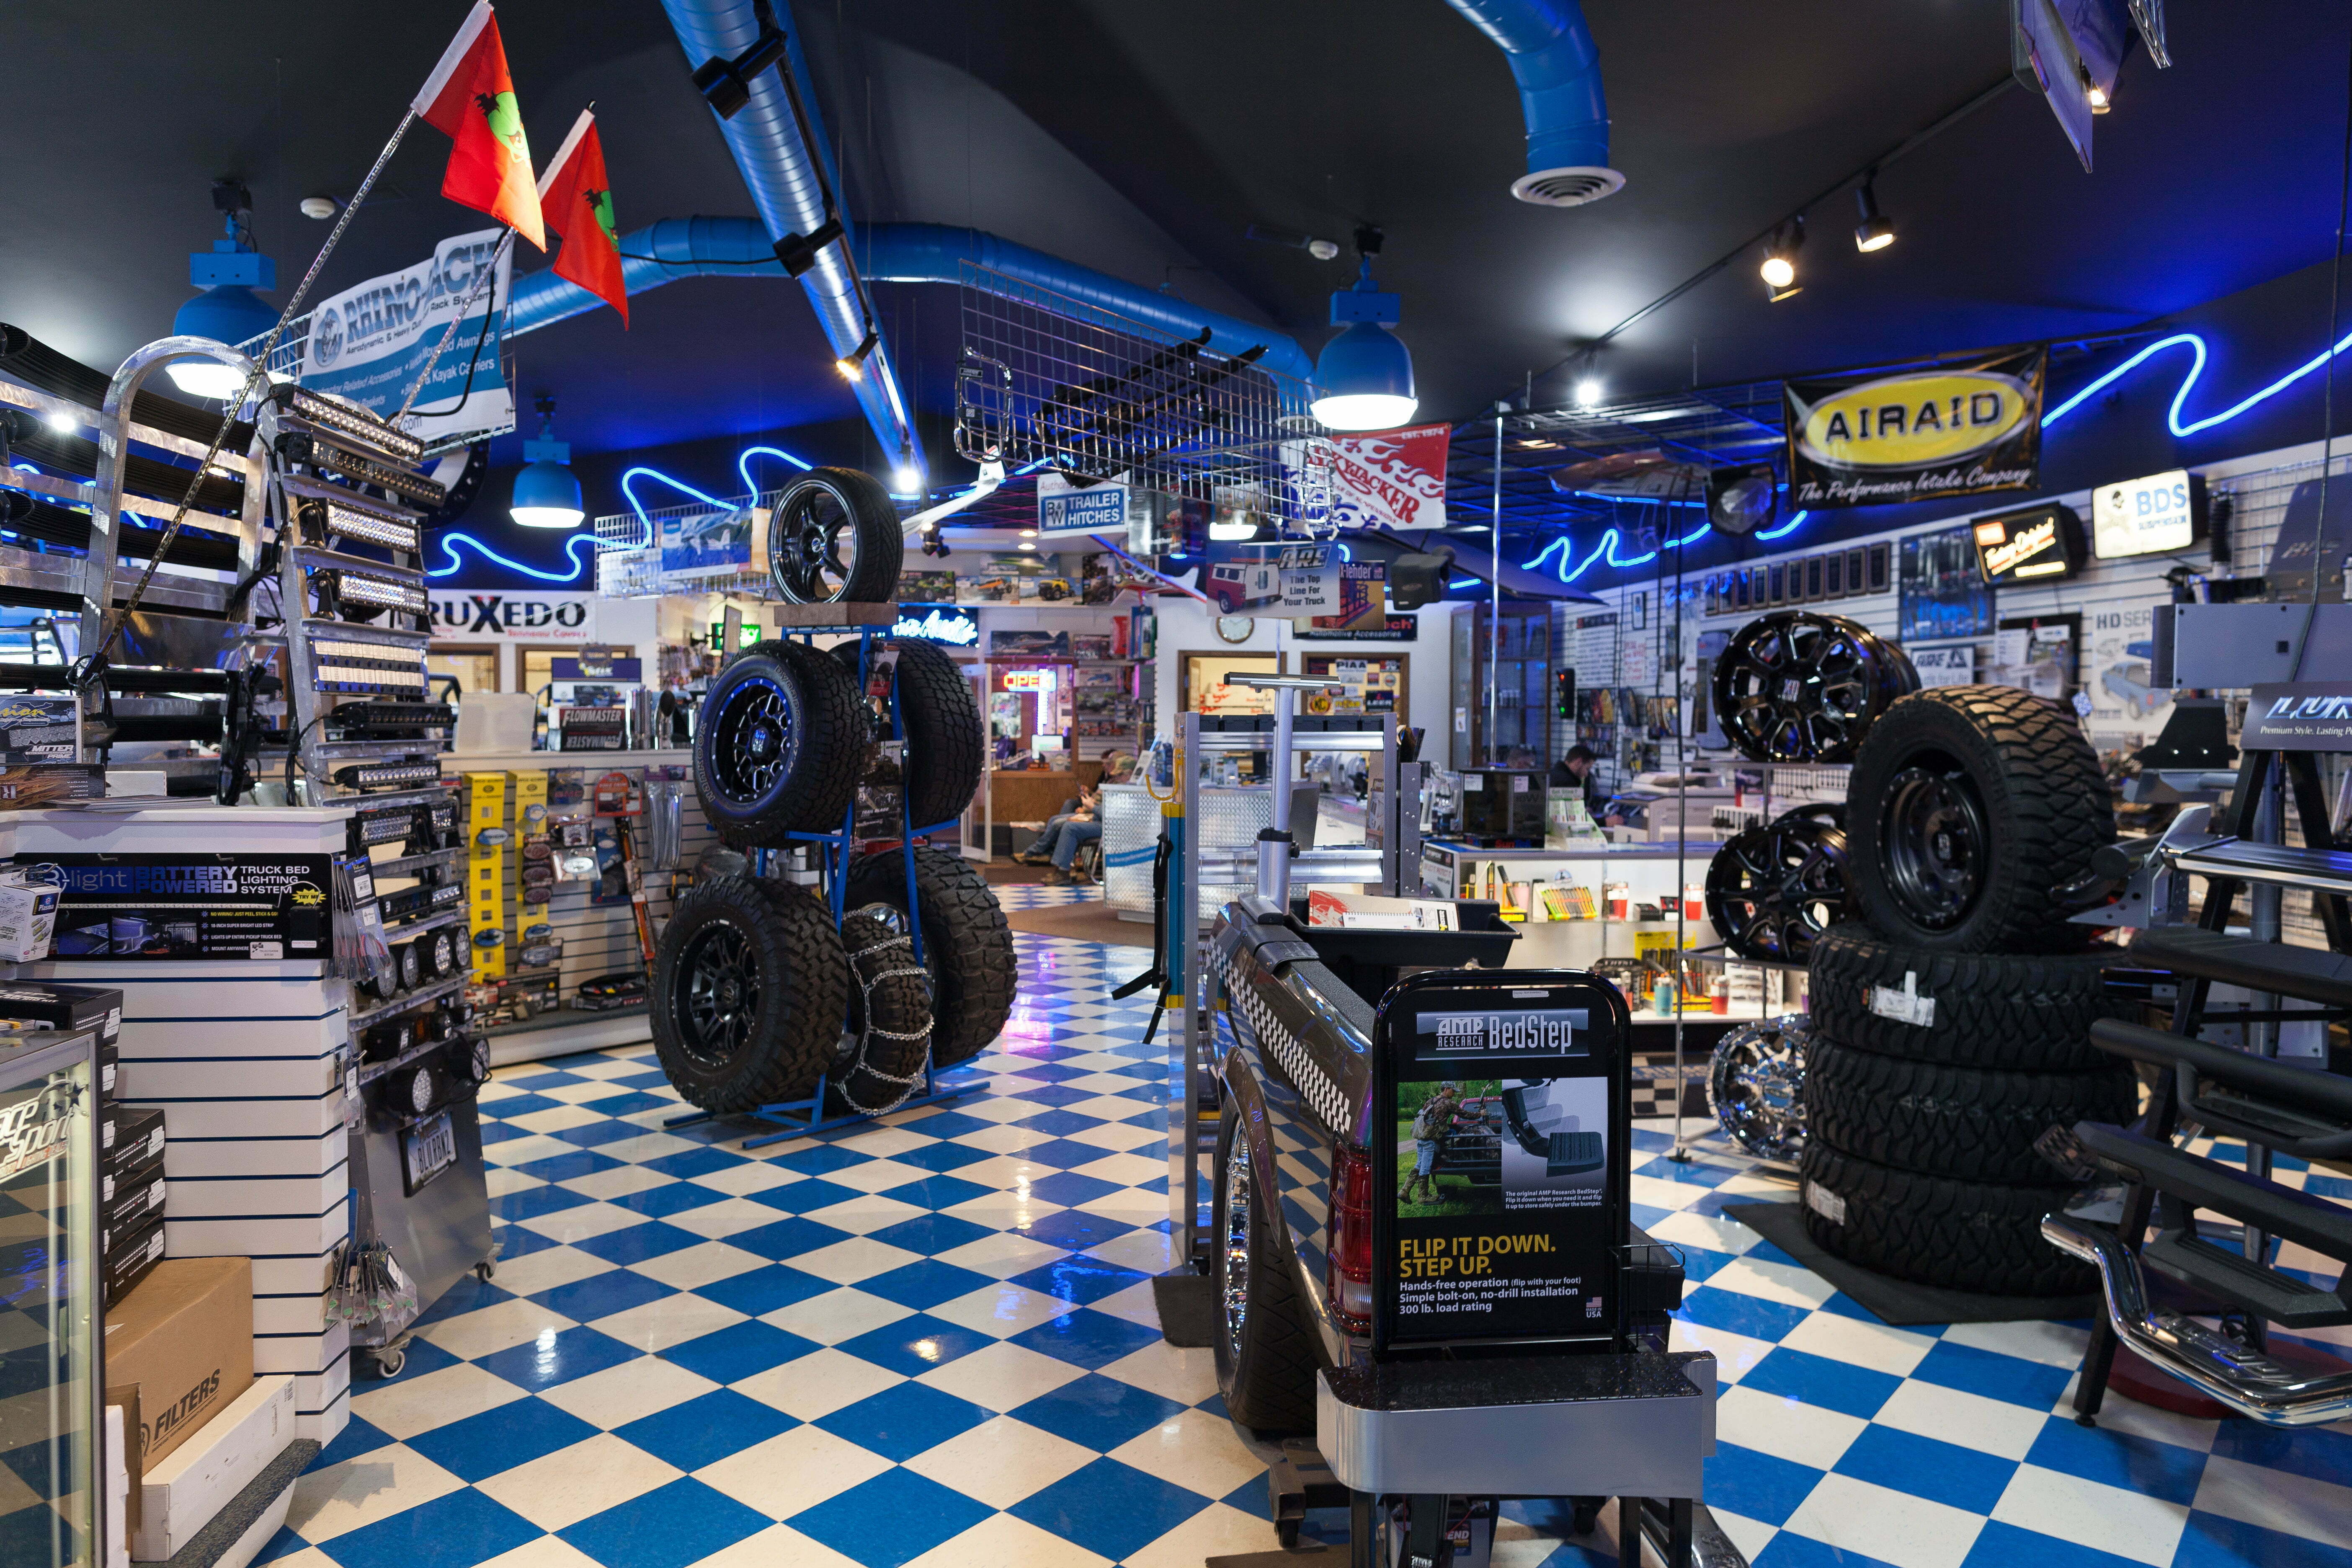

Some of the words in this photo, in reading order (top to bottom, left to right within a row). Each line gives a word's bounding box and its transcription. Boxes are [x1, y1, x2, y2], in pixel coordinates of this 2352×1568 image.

[346, 338, 383, 355] Aerodynamic
[387, 332, 392, 341] &
[431, 297, 449, 311] Rack
[457, 331, 495, 351] Awnigs
[369, 366, 402, 384] Accessories
[433, 365, 457, 382] Kayak
[459, 358, 495, 376] Cariers
[1825, 391, 2004, 445] AIRAID
[1423, 428, 1444, 438] 1974
[1308, 446, 1420, 524] SKYJACKER
[1799, 482, 1823, 503] The
[1826, 477, 1914, 503] Performance
[1915, 469, 1965, 491] Intake
[1966, 465, 2032, 487] Company
[1069, 493, 1120, 509] TRAILER
[2136, 484, 2187, 516] BDS
[1068, 508, 1120, 525] HITCHES
[1308, 575, 1320, 585] Top
[1305, 597, 1325, 605] Truck
[402, 595, 586, 633] RUXEDO
[2123, 609, 2152, 627] SER
[1354, 629, 1402, 638] Accessories
[562, 709, 622, 727] FLOWMASTER
[2261, 725, 2292, 734] Premium
[2294, 726, 2314, 737] Style.
[2316, 727, 2344, 738] Lasting
[135, 867, 237, 879] BATTERY
[135, 880, 237, 893] POWERED
[1438, 1018, 1484, 1034] AMP
[1489, 1015, 1571, 1055] BedStep
[1438, 1035, 1483, 1048] RESEARCH
[1400, 1238, 1446, 1258] FLIP
[1452, 1237, 1472, 1256] IT
[1478, 1234, 1556, 1255] DOWN.
[1400, 1257, 1453, 1277] STEP
[1460, 1256, 1492, 1275] UP.
[1400, 1279, 1456, 1292] Hands-free
[1459, 1278, 1509, 1291] operation
[1511, 1278, 1526, 1287] (flip
[1527, 1277, 1544, 1286] with
[1545, 1278, 1562, 1287] your
[1563, 1276, 1581, 1286] foot)
[1400, 1291, 1435, 1305] Simple
[1437, 1290, 1478, 1302] bolt-on,
[1481, 1288, 1519, 1300] no-drill
[1521, 1287, 1578, 1297] installation
[1400, 1304, 1419, 1314] 300
[1421, 1303, 1434, 1313] lb.
[1436, 1302, 1458, 1313] load
[1461, 1301, 1492, 1313] rating
[153, 1368, 221, 1442] FILTERS
